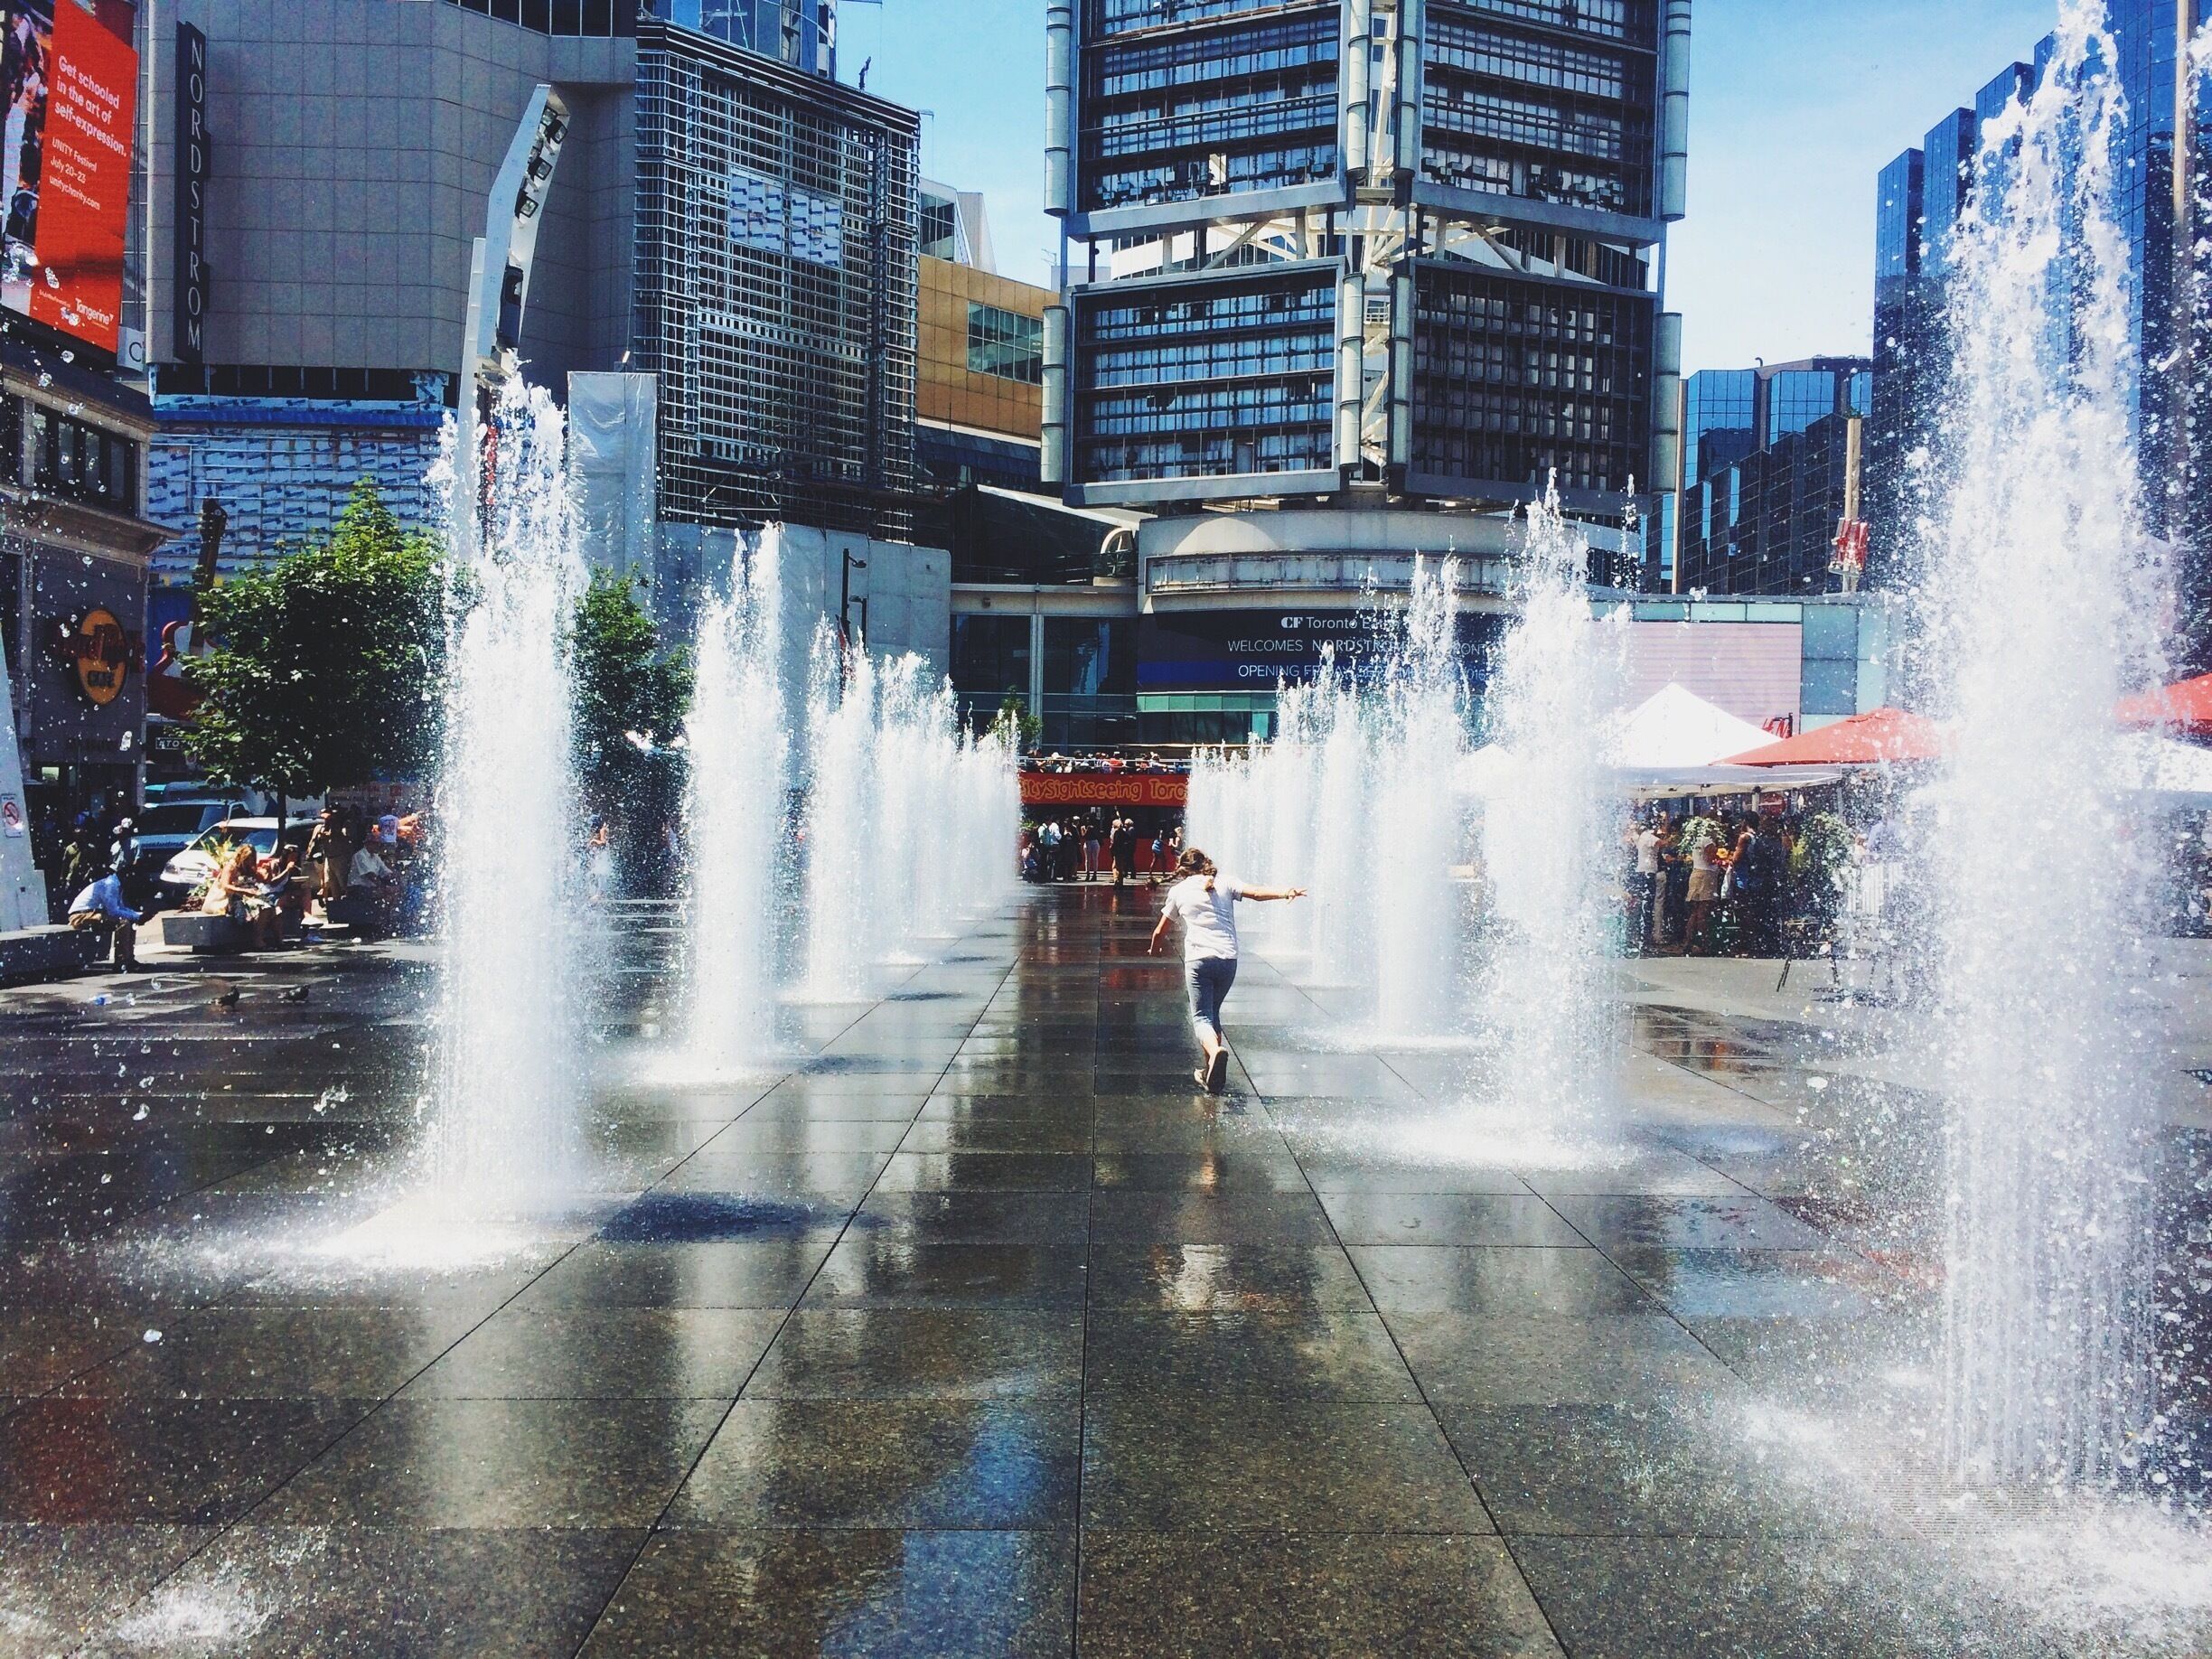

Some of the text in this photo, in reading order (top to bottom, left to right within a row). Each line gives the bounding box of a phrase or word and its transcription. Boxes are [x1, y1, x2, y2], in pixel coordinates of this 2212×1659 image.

[57, 75, 112, 125] in the art of
[59, 55, 119, 109] Get schooled
[55, 102, 127, 157] self-expression.
[51, 155, 64, 173] July
[52, 136, 98, 173] UNITY Festival
[49, 175, 100, 211] unitycharity.com
[188, 38, 203, 351] NORDSTROM
[75, 297, 111, 325] Tangerine
[1280, 616, 1303, 629] CF
[1306, 616, 1358, 629] Toronto
[1227, 639, 1304, 652] WELCOMES
[1238, 664, 1299, 678] OPENING
[1304, 664, 1352, 679] FRAY
